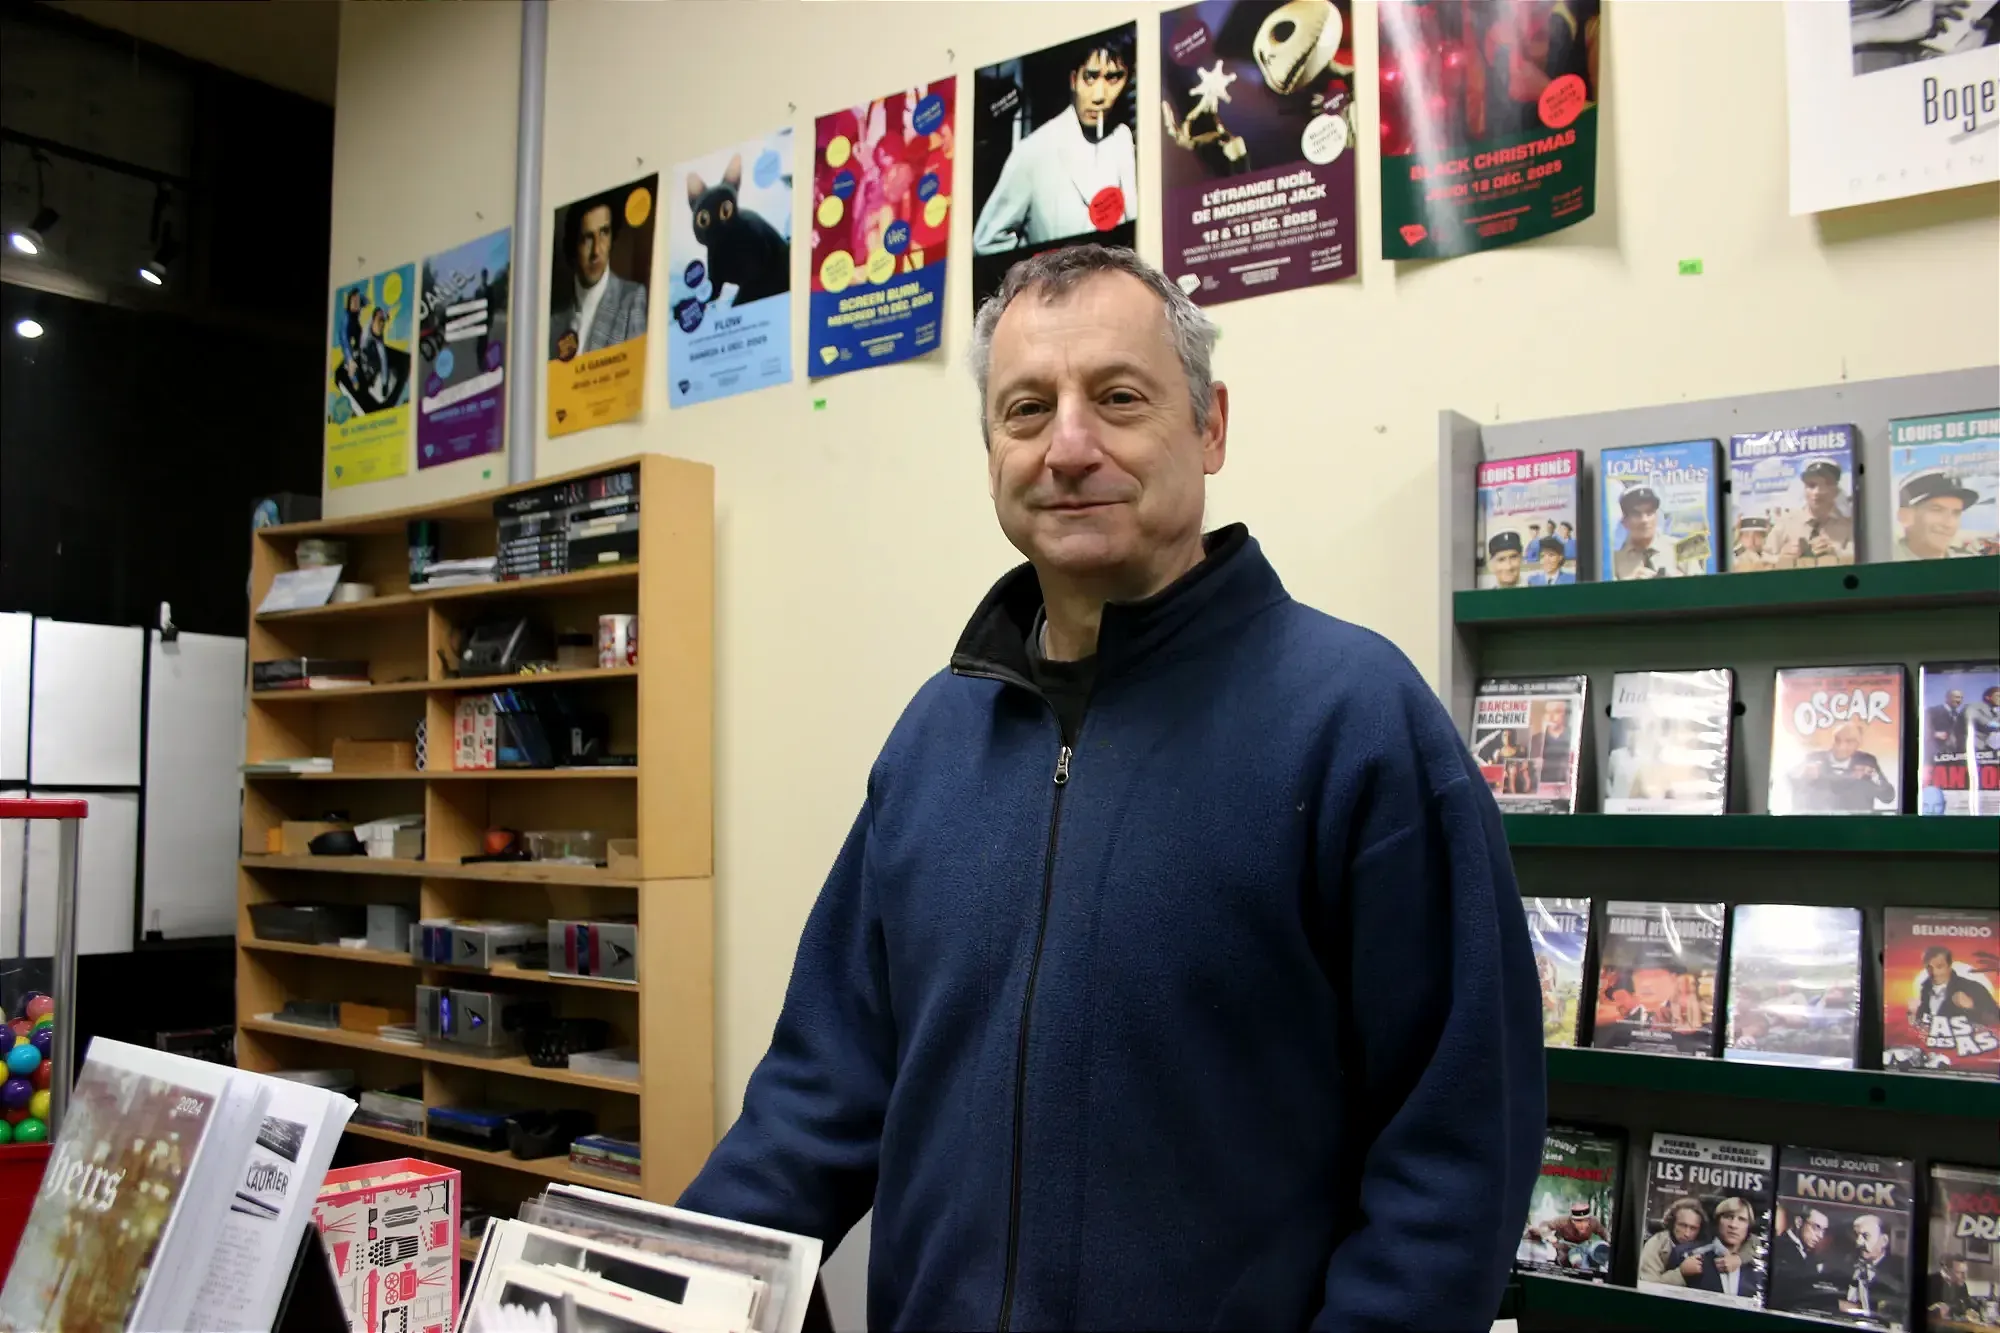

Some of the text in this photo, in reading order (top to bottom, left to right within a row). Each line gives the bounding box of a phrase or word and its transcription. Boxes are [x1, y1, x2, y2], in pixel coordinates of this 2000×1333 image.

[1922, 76, 2000, 132] Boge
[1410, 129, 1577, 181] BLACK CHRISTMAS
[1277, 169, 1315, 191] NOËL
[1527, 160, 1562, 181] 2025
[1192, 209, 1211, 224] DE
[1213, 192, 1287, 221] MONSIEUR
[1288, 184, 1326, 204] JACK
[1202, 229, 1219, 243] 12
[1282, 209, 1317, 227] 2025
[1898, 424, 1943, 442] LOUIS
[1946, 422, 1966, 438] DE
[1482, 457, 1572, 484] LOUIS DE FUNÈS
[1478, 701, 1527, 723] DANCING MACHINE
[1793, 688, 1892, 735] OSCAR
[1609, 917, 1646, 935] MANON
[1912, 924, 1992, 938] BELMONDO
[1926, 1032, 1998, 1056] DES AS
[176, 1096, 204, 1116] 2024
[1663, 1139, 1697, 1149] PIERRE
[1659, 1147, 1765, 1165] RICHARD DEPARDIEU
[1810, 1156, 1879, 1172] LOUIS JOUVET
[246, 1164, 289, 1196] LAURIER
[1657, 1161, 1684, 1181] LES
[1689, 1165, 1763, 1191] FUGITIFS
[1797, 1174, 1895, 1207] KNOCK
